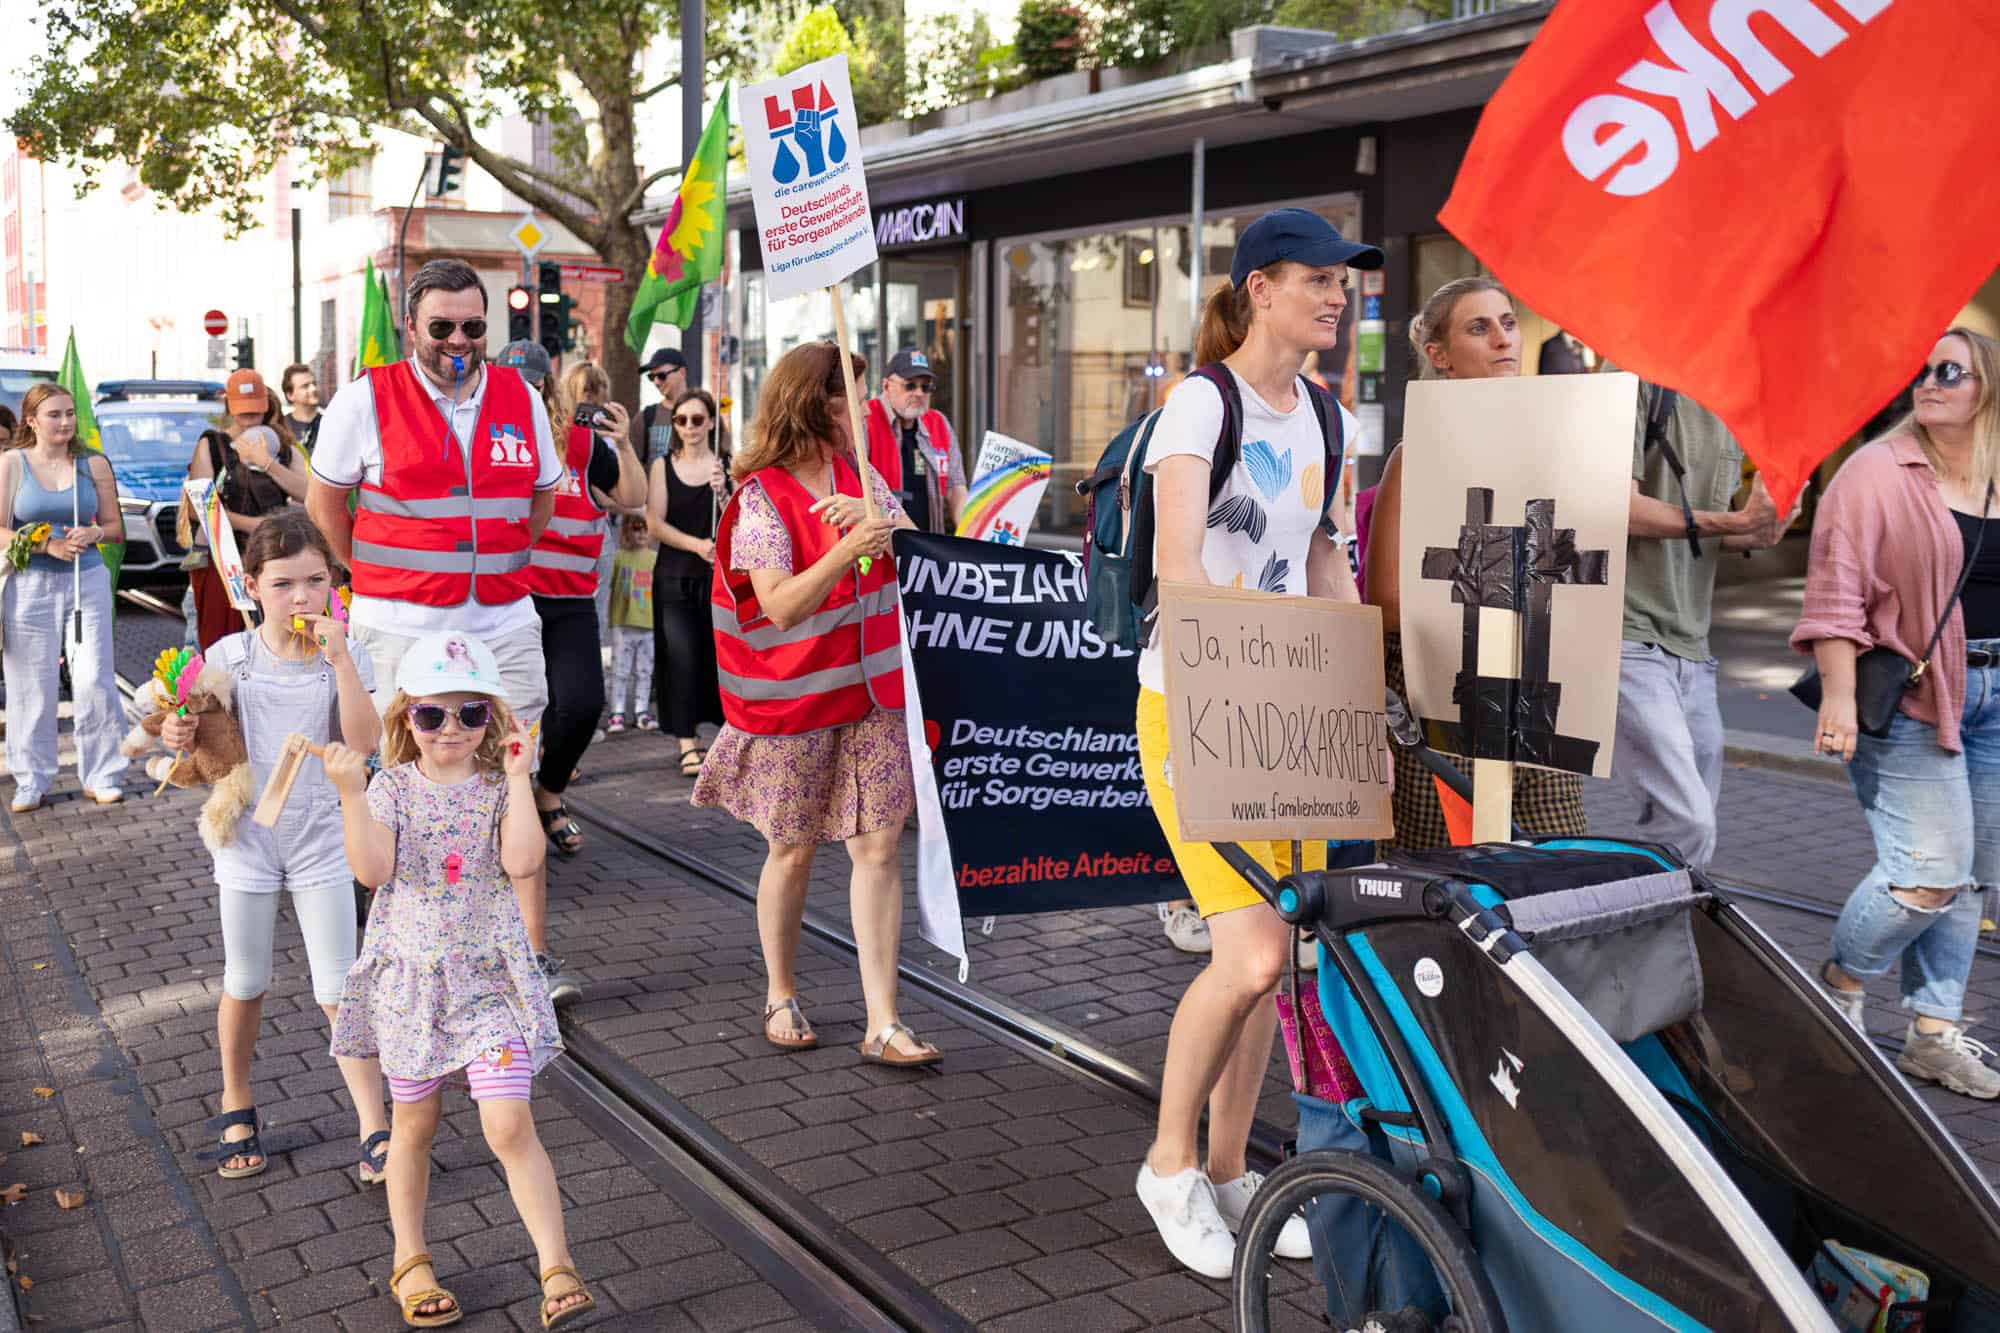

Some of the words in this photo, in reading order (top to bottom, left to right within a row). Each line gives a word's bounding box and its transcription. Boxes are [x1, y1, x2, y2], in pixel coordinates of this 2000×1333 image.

[774, 188, 790, 198] die
[781, 184, 851, 219] Deutschlands
[765, 222, 798, 238] erste
[799, 191, 863, 228] Gewerkschaft
[768, 238, 786, 253] für
[788, 205, 866, 243] Sorgearbeitende
[771, 260, 791, 273] Liga
[791, 257, 804, 267] für
[898, 555, 1088, 604] UNBEZAH
[907, 609, 1013, 654] HNE
[1180, 618, 1230, 669] Ja,
[1240, 624, 1275, 668] ich
[1286, 632, 1329, 672] will:
[944, 752, 1020, 777] erste
[941, 781, 980, 809] für
[1232, 791, 1360, 821] www.familienbonus.de
[955, 855, 1068, 888] bezahlte
[1072, 851, 1151, 878] Arbeit
[1358, 878, 1403, 899] THULE
